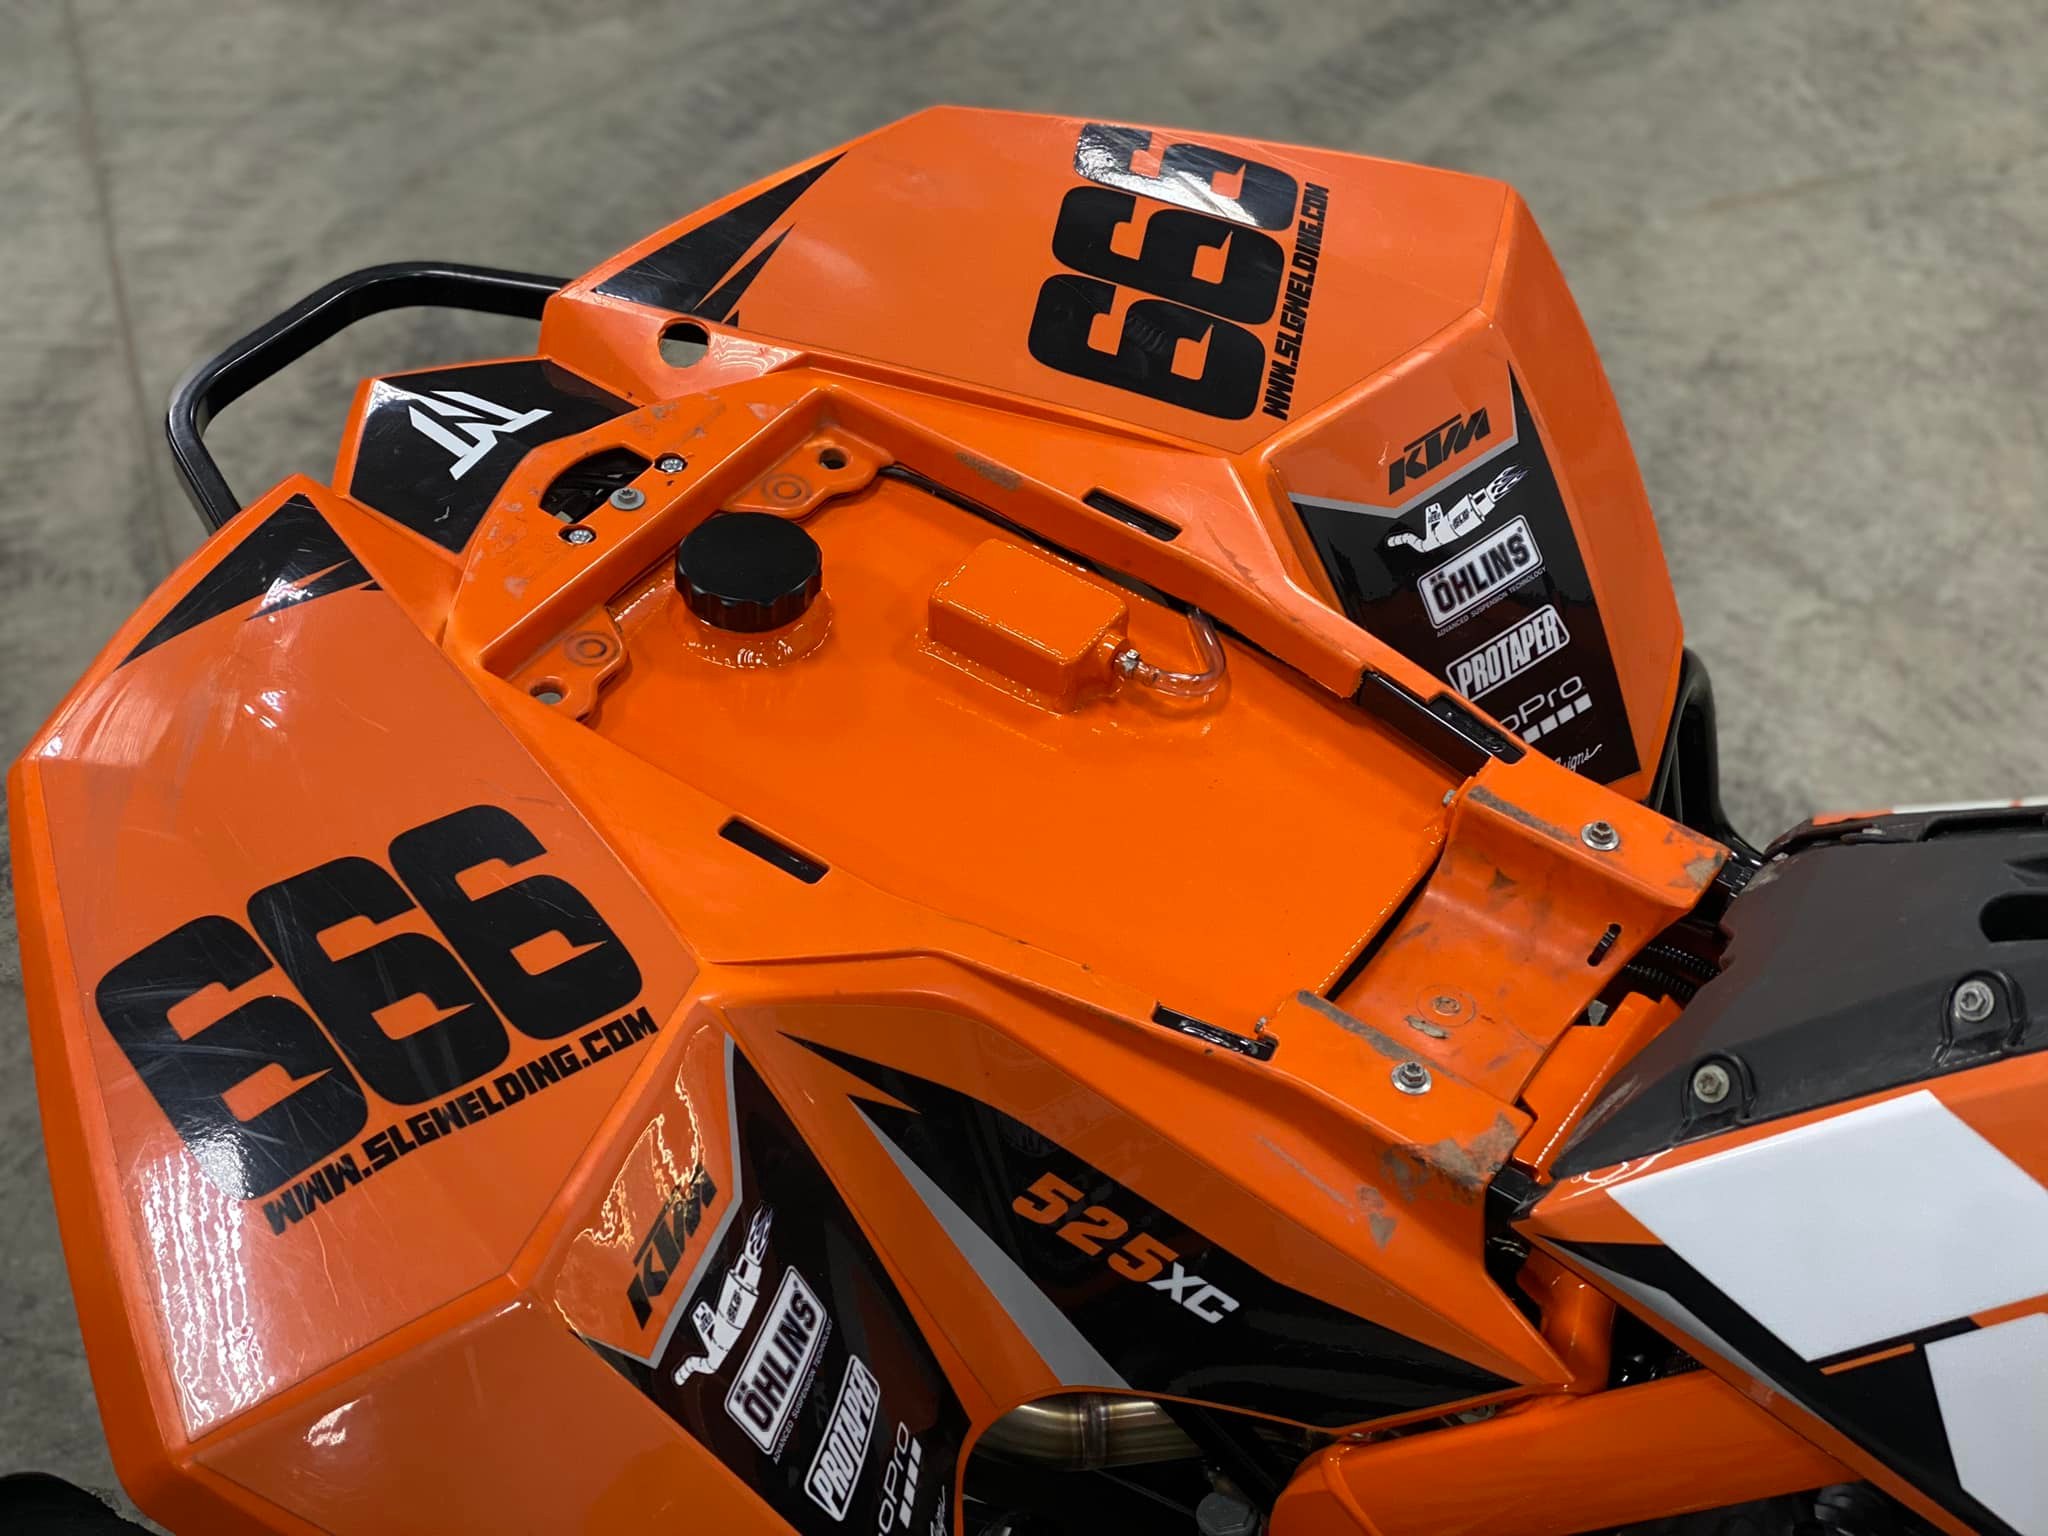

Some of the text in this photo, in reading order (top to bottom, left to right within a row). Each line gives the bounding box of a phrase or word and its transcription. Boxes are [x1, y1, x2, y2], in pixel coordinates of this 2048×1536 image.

[1028, 122, 1298, 420] 666
[1262, 182, 1329, 421] WWW.SLGWELDING.COM
[1388, 406, 1491, 496] KTM
[1430, 533, 1530, 614] ÖHLINS
[1436, 614, 1469, 638] ADVANCED
[1456, 612, 1564, 697] PROTAPER
[1500, 675, 1583, 732] oPro
[95, 804, 643, 1200] 666
[261, 1005, 659, 1236] WWW.SLGWELDING.COM
[626, 1162, 718, 1331] KTM
[734, 1289, 819, 1433] ÖHLINS
[812, 1365, 879, 1511] PROTAPER
[878, 1421, 909, 1536] oPro
